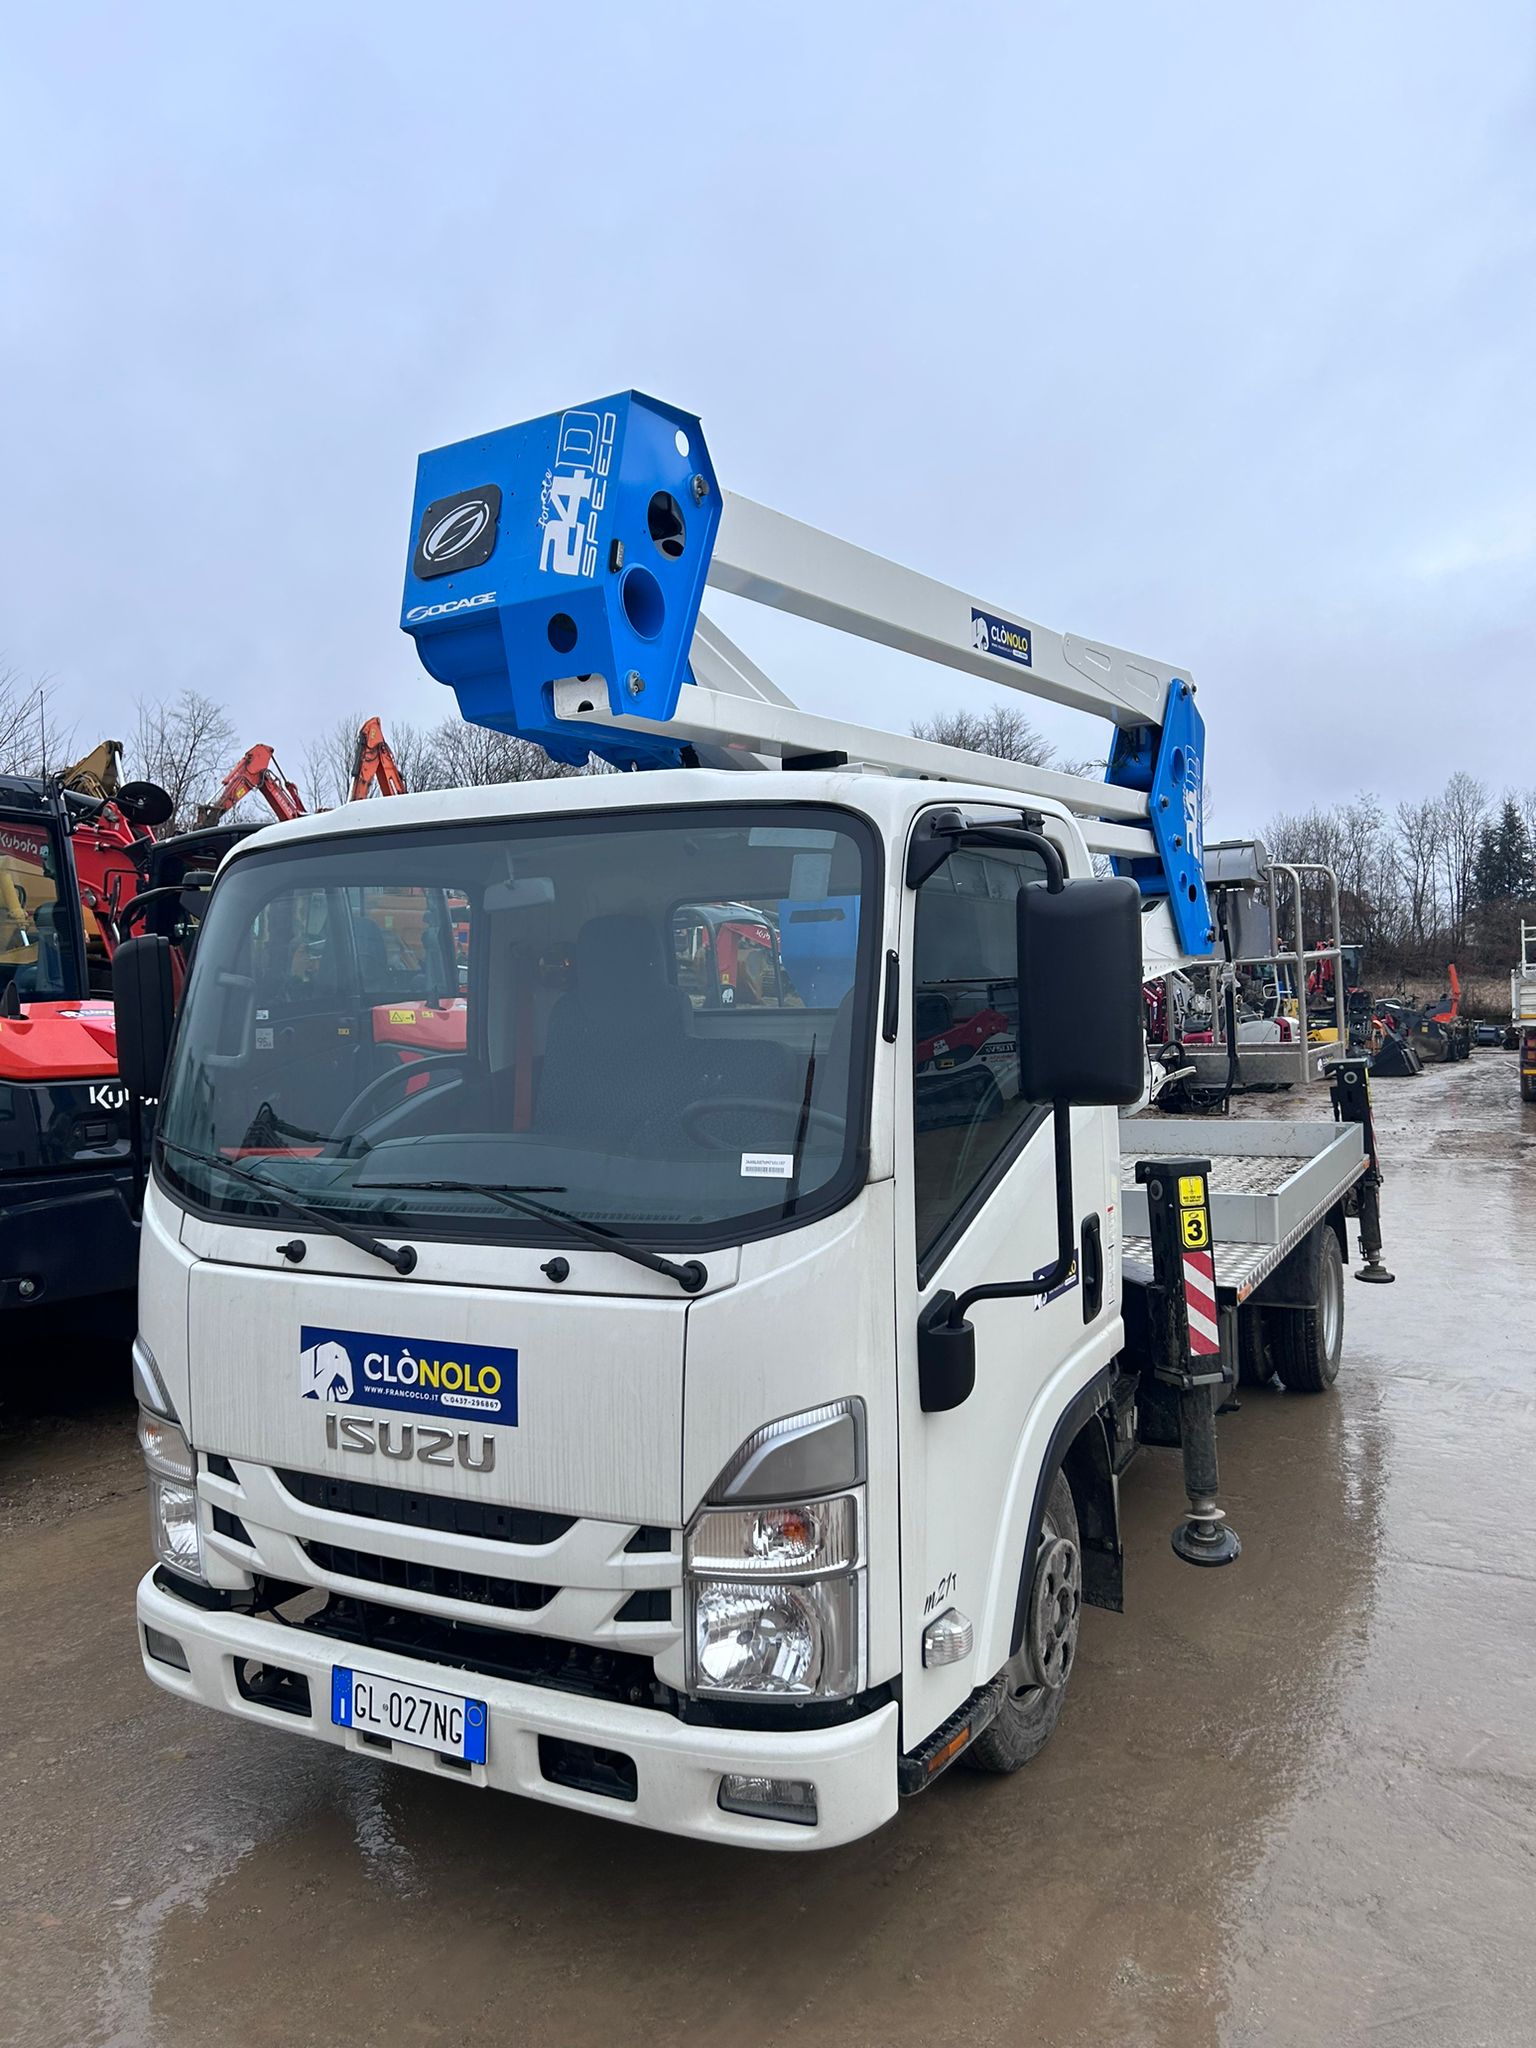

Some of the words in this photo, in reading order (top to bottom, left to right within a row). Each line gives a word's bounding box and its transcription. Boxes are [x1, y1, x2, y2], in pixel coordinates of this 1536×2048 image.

[582, 412, 616, 578] SPEED
[1187, 1219, 1203, 1241] 3
[363, 1348, 501, 1395] CLÒNOLO
[326, 1412, 496, 1473] ISUZU
